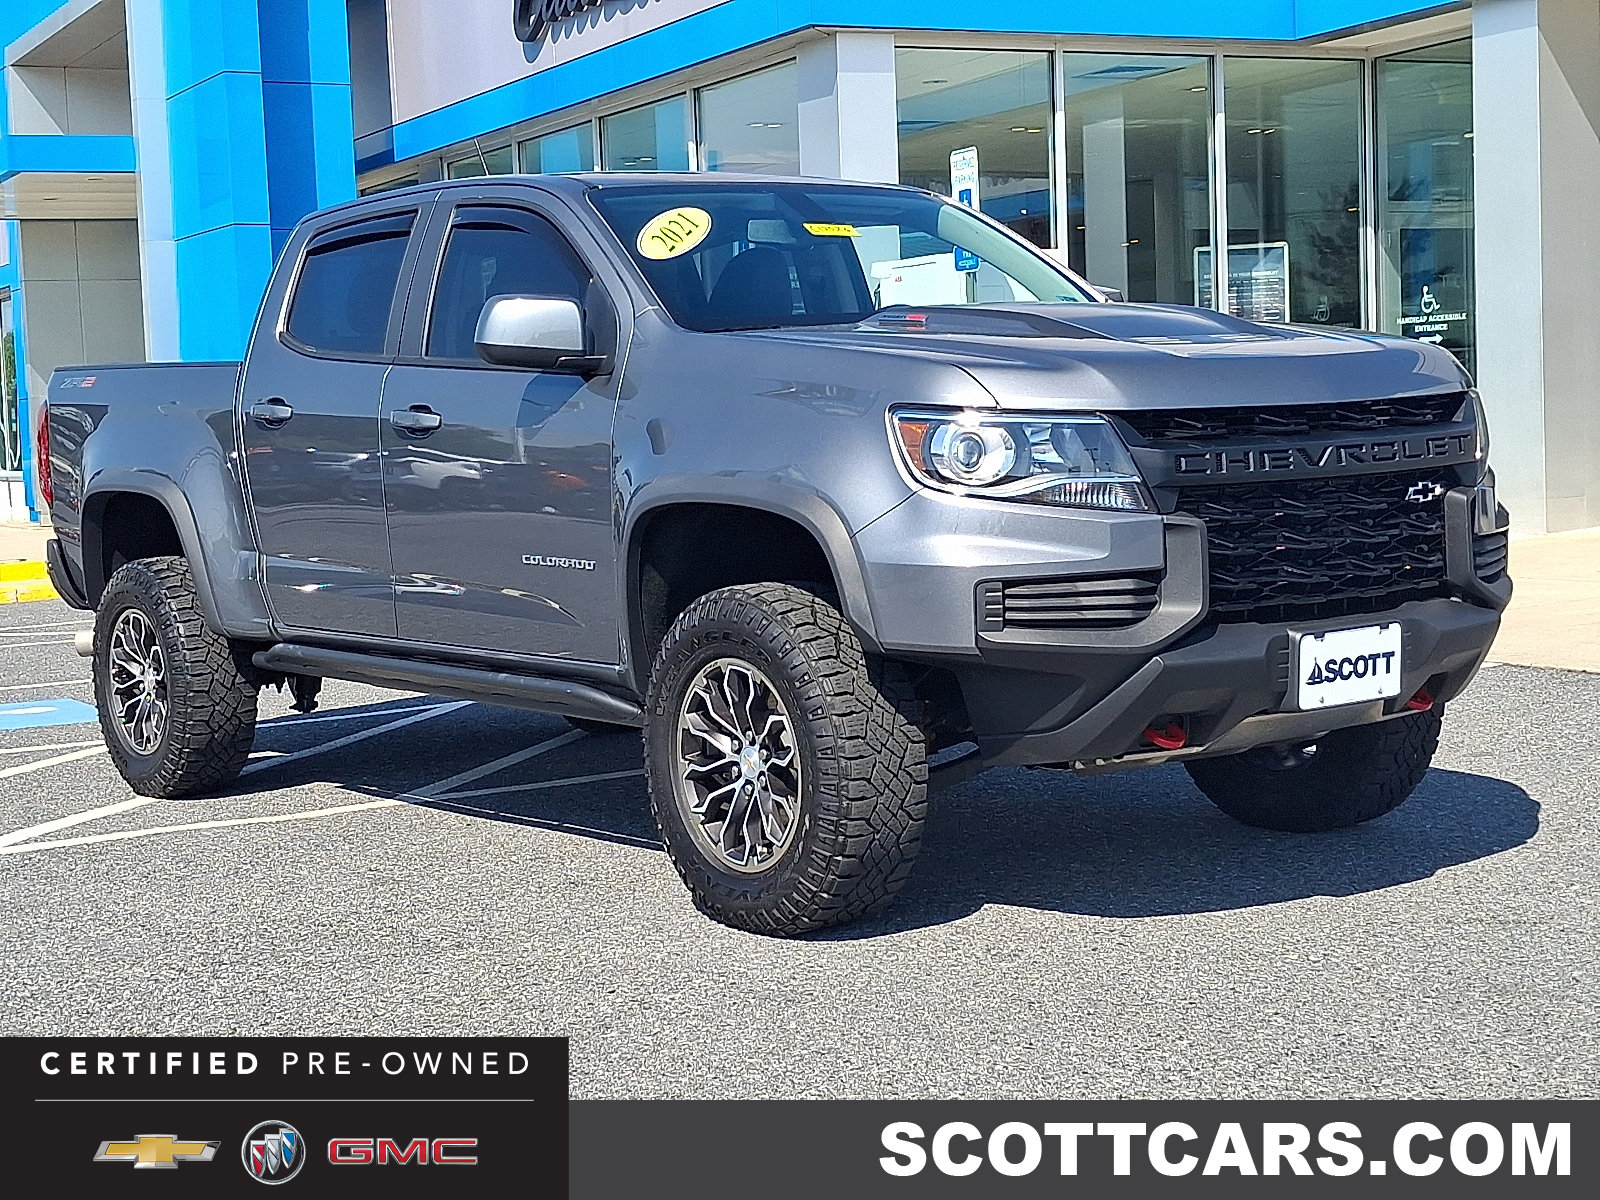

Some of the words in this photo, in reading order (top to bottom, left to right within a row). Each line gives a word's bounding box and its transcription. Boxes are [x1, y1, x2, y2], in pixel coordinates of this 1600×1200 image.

[651, 212, 700, 253] 2021
[1396, 315, 1428, 325] HANDICAP
[1428, 312, 1467, 322] ACCESSIBLE
[1414, 323, 1449, 333] ENTRANCE
[1175, 433, 1471, 475] CHEVROLET
[521, 554, 597, 570] COLORADO
[1324, 650, 1395, 683] SCOTT
